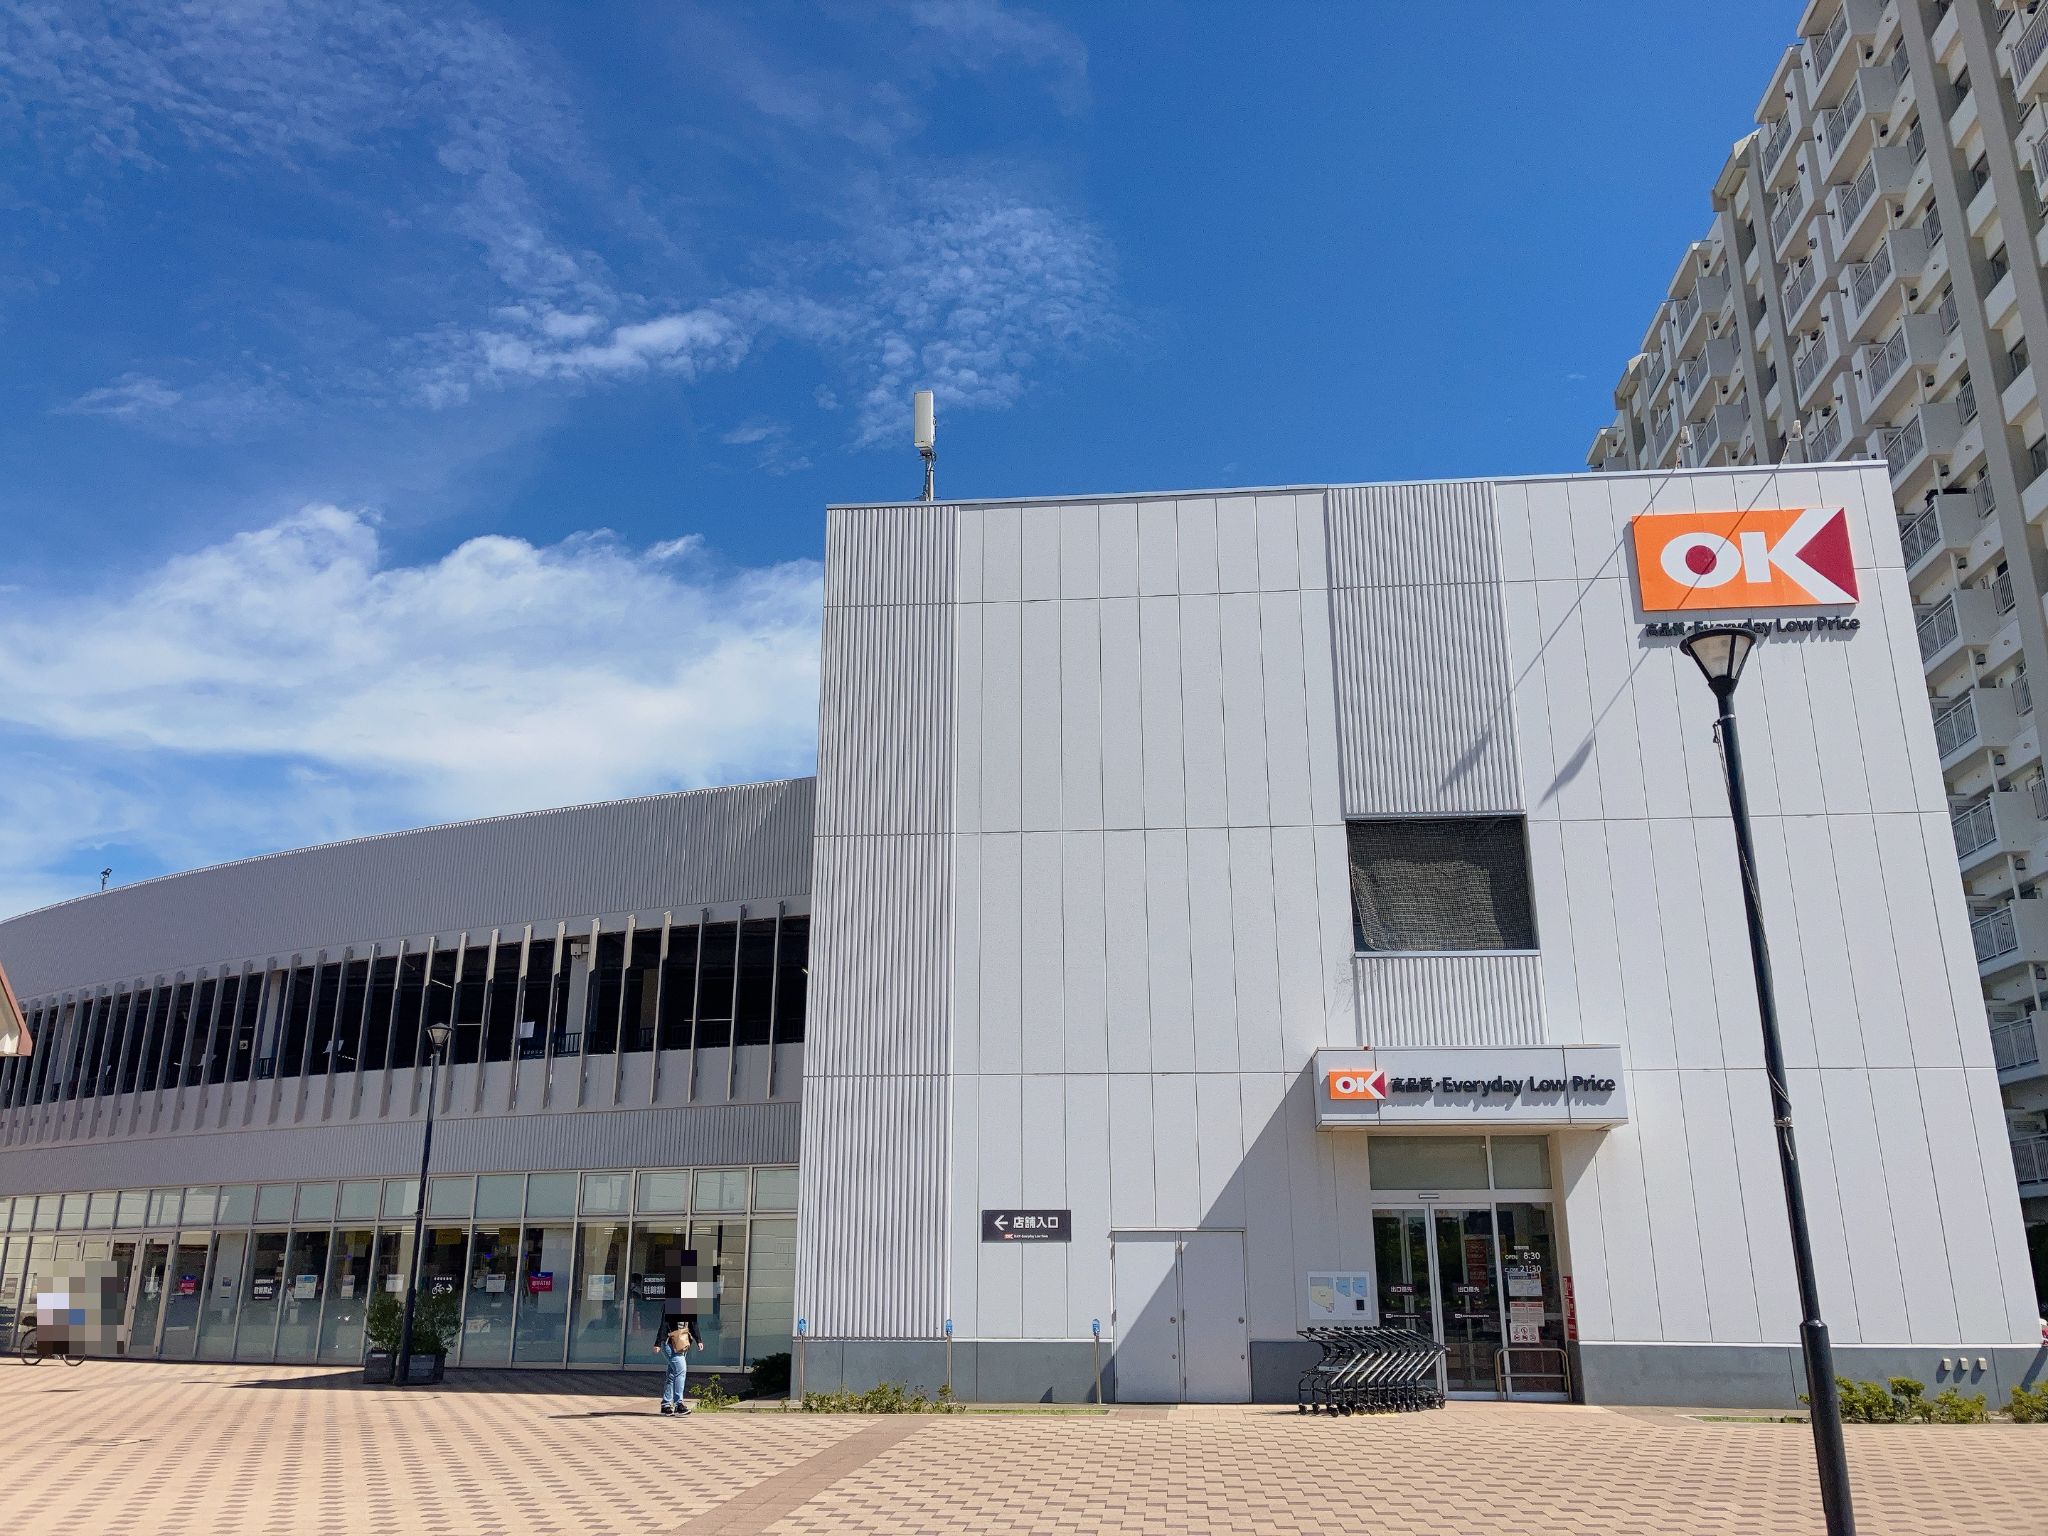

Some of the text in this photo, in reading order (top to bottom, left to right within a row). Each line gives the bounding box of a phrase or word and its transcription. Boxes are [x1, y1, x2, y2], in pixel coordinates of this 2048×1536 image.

[1660, 507, 1859, 604] OK
[1776, 618, 1813, 633] Low
[1817, 615, 1860, 631] Price
[1335, 1070, 1386, 1100] OK
[1529, 1076, 1567, 1092] Low
[1572, 1075, 1616, 1092] Price
[1013, 1216, 1059, 1229] 店舗入口
[1523, 1251, 1541, 1260] 8:30
[1519, 1264, 1542, 1273] 21:30
